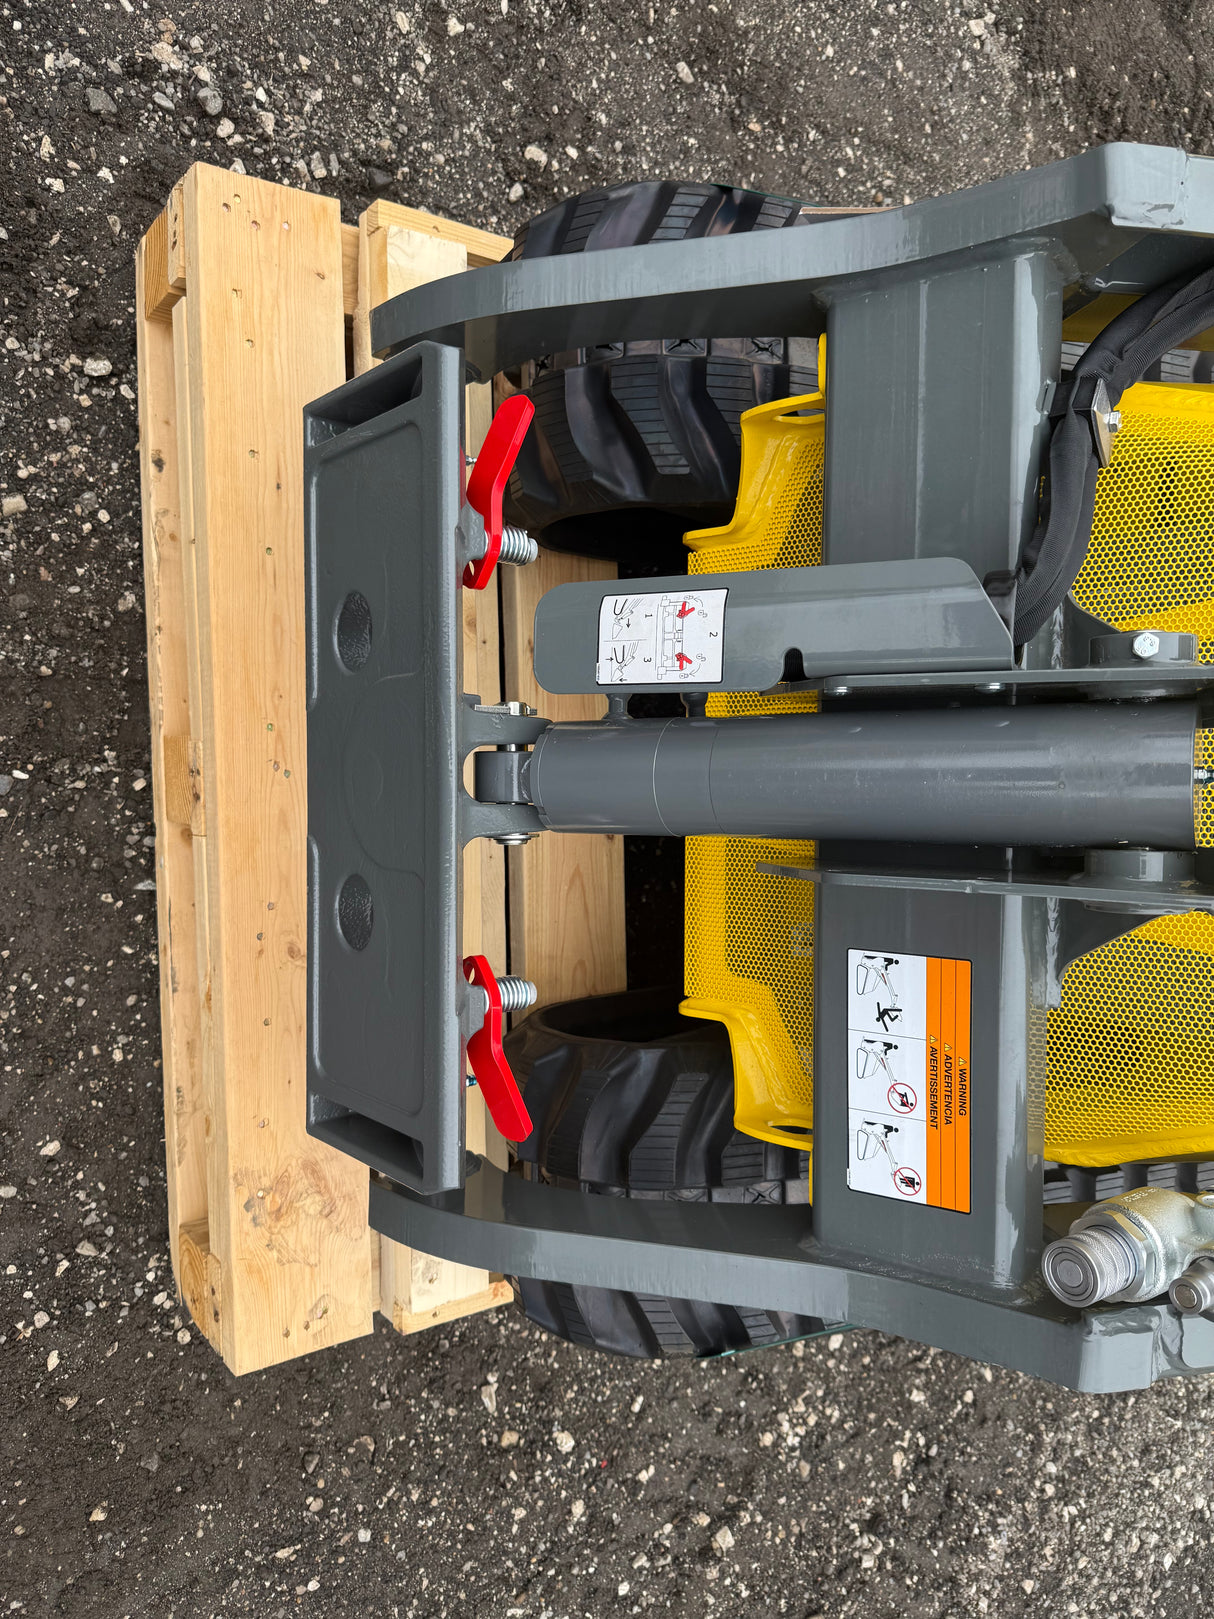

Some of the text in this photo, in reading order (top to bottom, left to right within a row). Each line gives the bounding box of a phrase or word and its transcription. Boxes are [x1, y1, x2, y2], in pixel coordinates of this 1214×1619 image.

[929, 1046, 938, 1130] AVERTISSEMENT
[944, 1054, 953, 1126] ADVERTENCIA
[958, 1068, 967, 1117] WARNING
